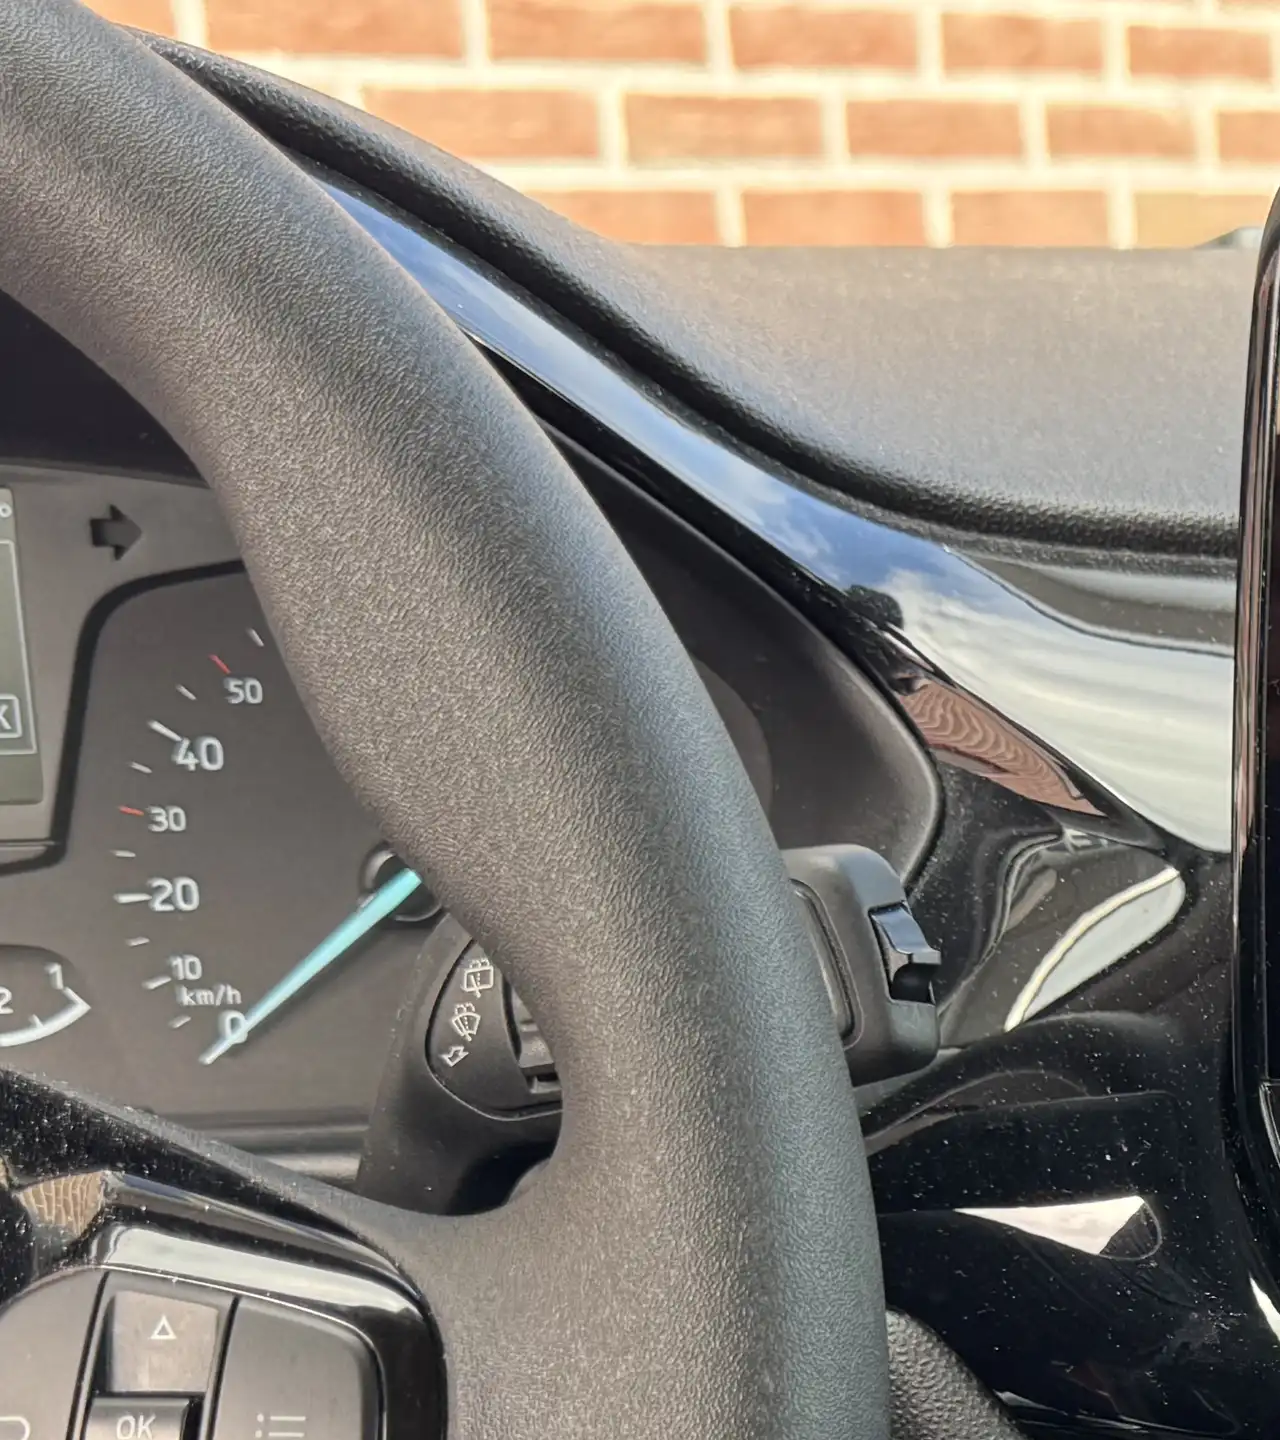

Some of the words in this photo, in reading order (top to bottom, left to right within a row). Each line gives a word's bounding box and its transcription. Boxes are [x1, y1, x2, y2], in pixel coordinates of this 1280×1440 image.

[225, 677, 264, 705] 50
[175, 740, 224, 771] 40
[147, 806, 187, 832] 30
[150, 878, 198, 910] 20
[46, 962, 64, 990] 1
[170, 956, 202, 980] 10
[179, 984, 242, 1008] km/h
